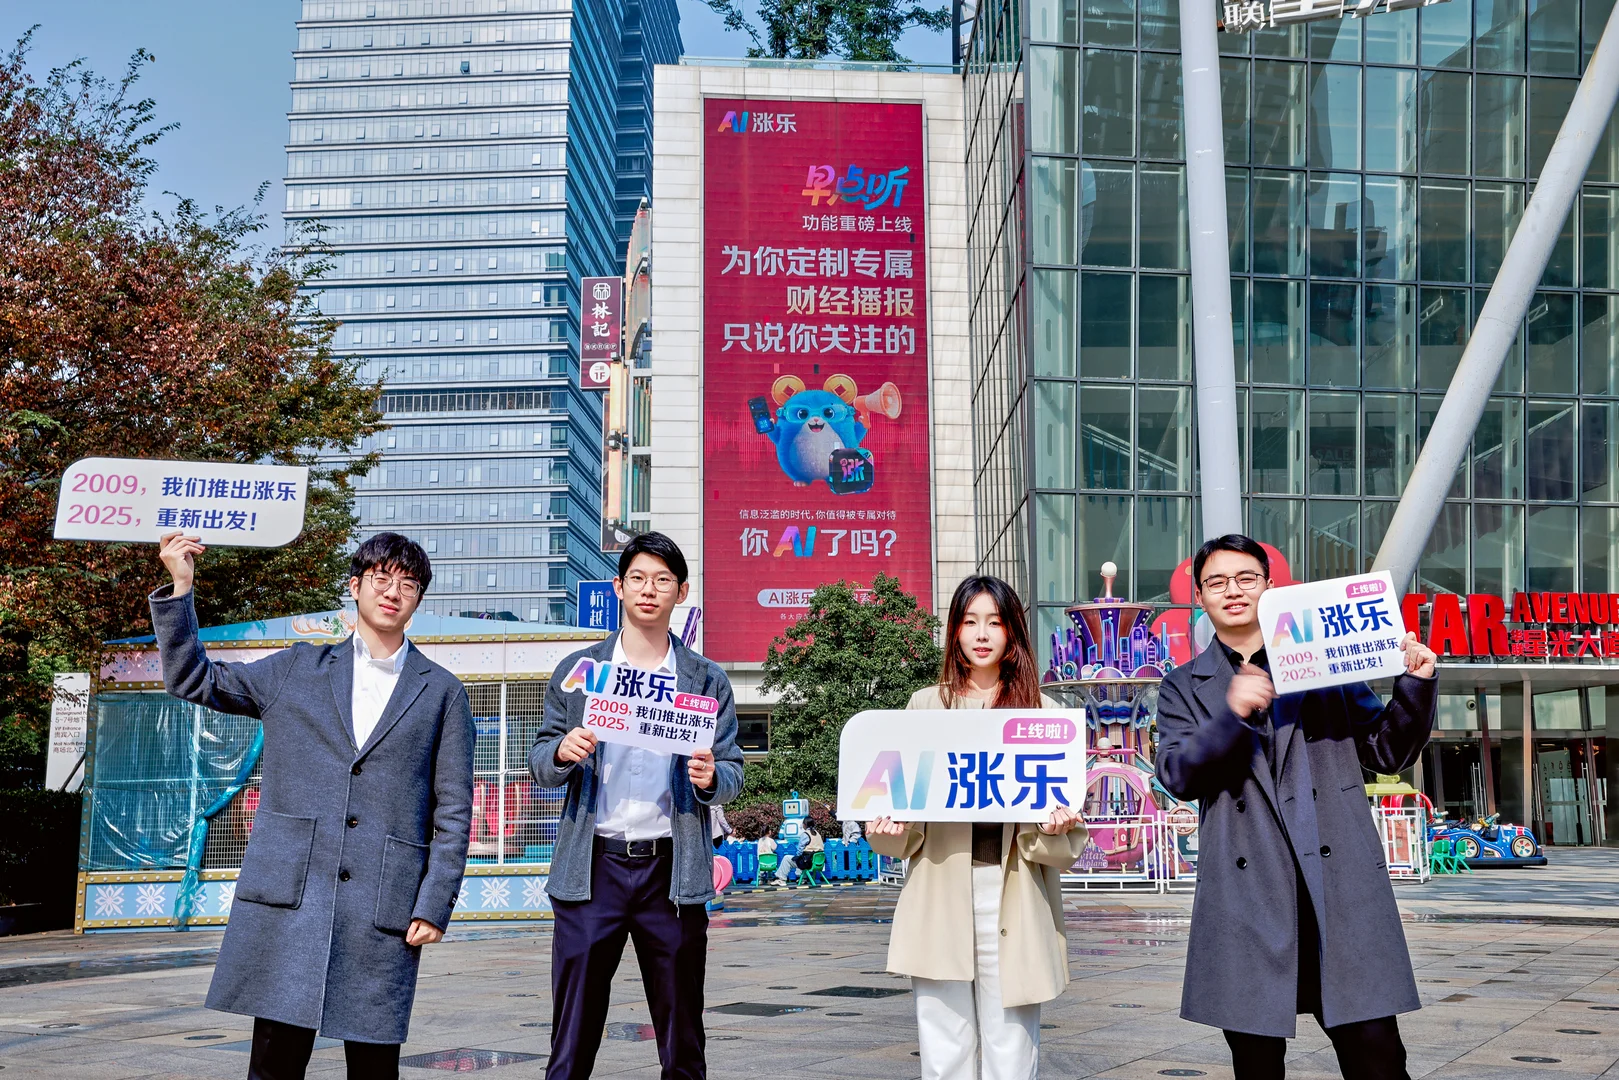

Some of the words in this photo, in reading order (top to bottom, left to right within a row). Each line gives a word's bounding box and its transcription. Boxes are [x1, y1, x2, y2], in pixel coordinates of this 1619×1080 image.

[717, 110, 797, 134] AI涨乐
[801, 164, 910, 210] 早点听
[802, 215, 912, 233] 功能重磅上线
[721, 245, 913, 279] 为你定制专属
[786, 285, 915, 317] 财经播报
[721, 322, 916, 355] 只说你关注的
[594, 371, 606, 380] 1F
[1400, 593, 1510, 656] TAR
[1011, 722, 1068, 740] 上线啦！
